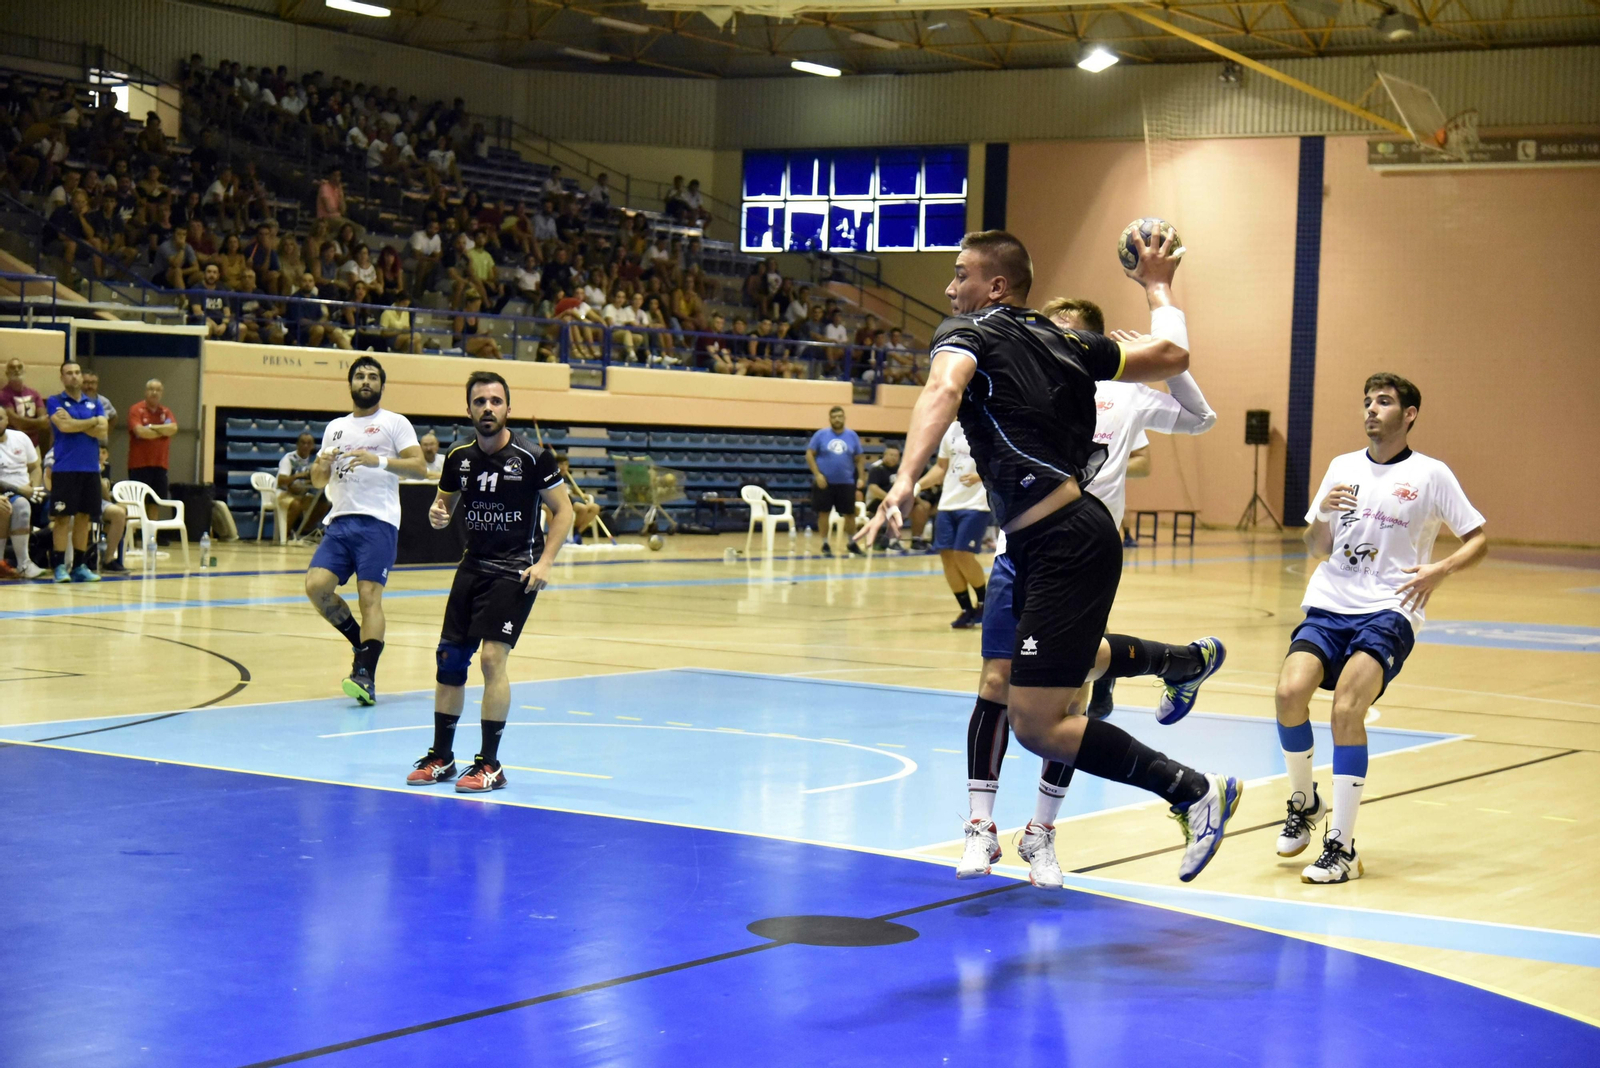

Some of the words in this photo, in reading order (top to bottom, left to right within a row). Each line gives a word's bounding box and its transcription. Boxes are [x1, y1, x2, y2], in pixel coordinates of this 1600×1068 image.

[262, 355, 302, 367] PRENSA
[332, 430, 343, 441] 20
[477, 471, 499, 492] 11
[471, 501, 505, 511] GRUPO
[465, 510, 522, 523] OLOMER
[1362, 508, 1410, 528] Hollywood
[467, 521, 510, 532] DENTAL
